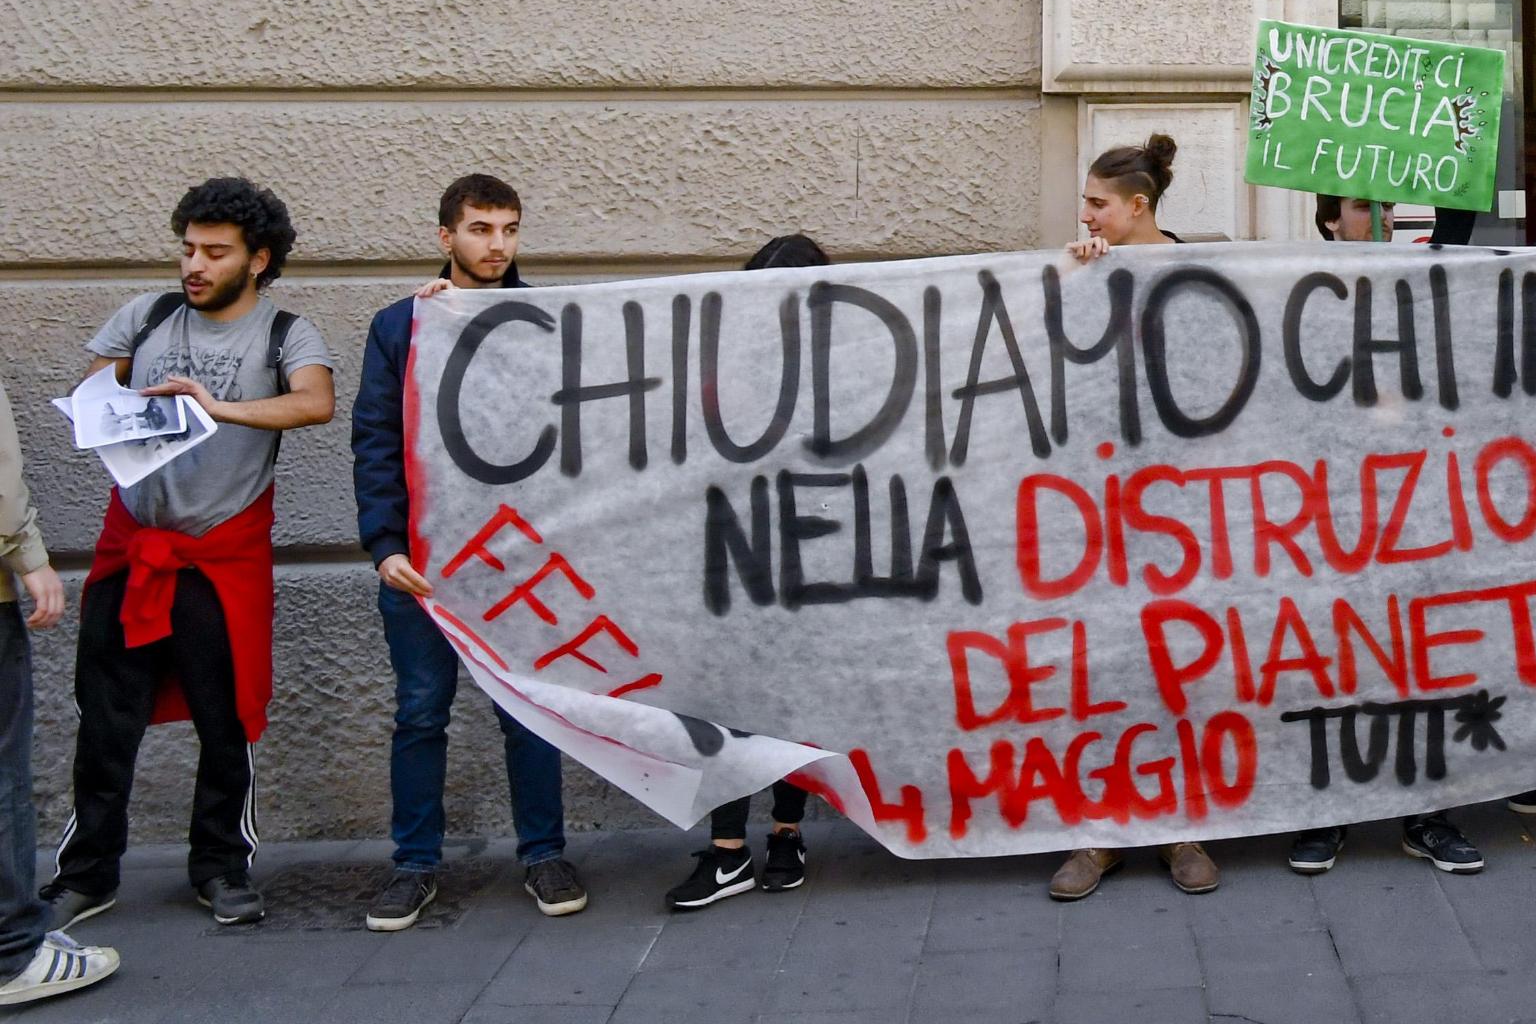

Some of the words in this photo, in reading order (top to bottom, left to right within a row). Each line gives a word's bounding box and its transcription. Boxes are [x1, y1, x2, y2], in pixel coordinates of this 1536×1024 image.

[1266, 72, 1460, 141] BRUCIA
[1310, 139, 1459, 192] FUTURO
[436, 263, 1261, 484] CHIUDIAMO
[1283, 264, 1462, 409] CHI
[702, 464, 983, 616] NELLA
[947, 616, 1127, 731] DEL
[947, 710, 1257, 842] MAGGIO
